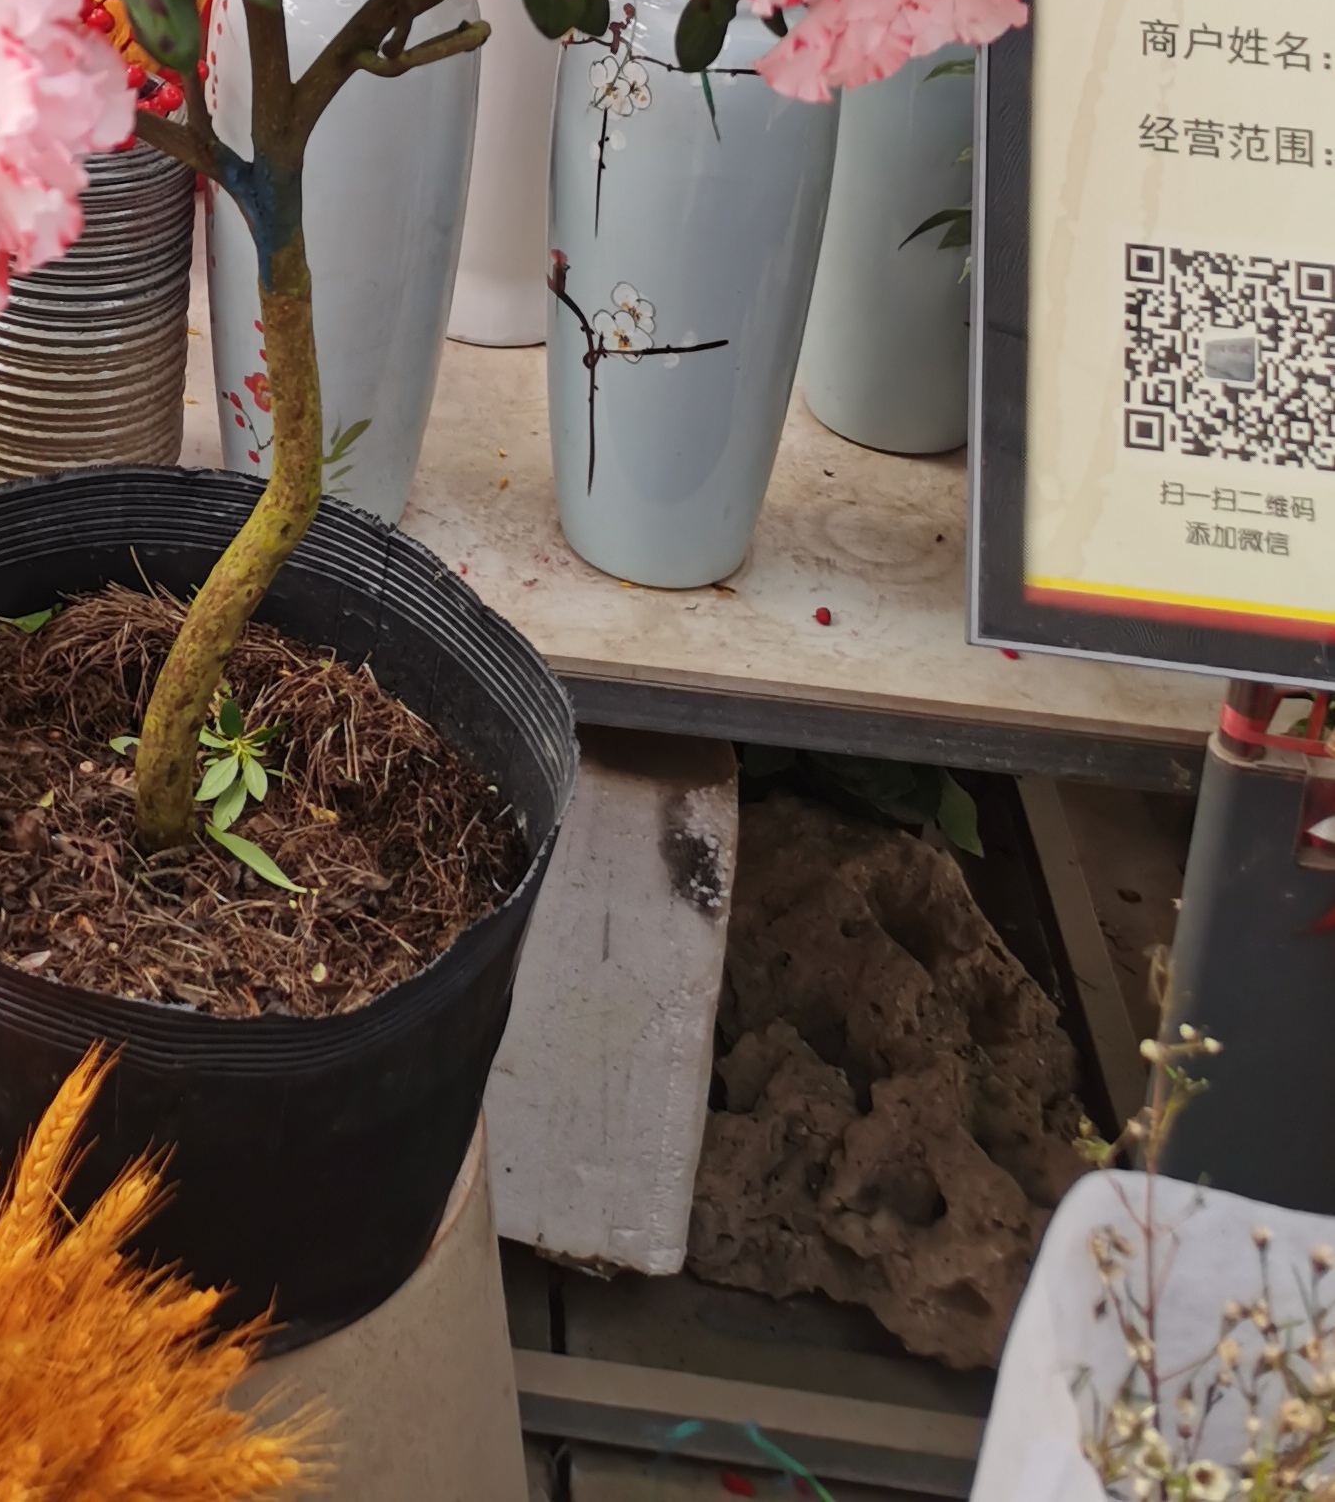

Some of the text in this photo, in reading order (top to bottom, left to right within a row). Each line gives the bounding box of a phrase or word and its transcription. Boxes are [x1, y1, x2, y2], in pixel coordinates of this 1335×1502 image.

[1139, 18, 1332, 73] 商户姓名：
[1138, 113, 1334, 169] 经营范围：
[1159, 479, 1316, 522] 扫一扫二维码
[1185, 519, 1291, 557] 添加微信
